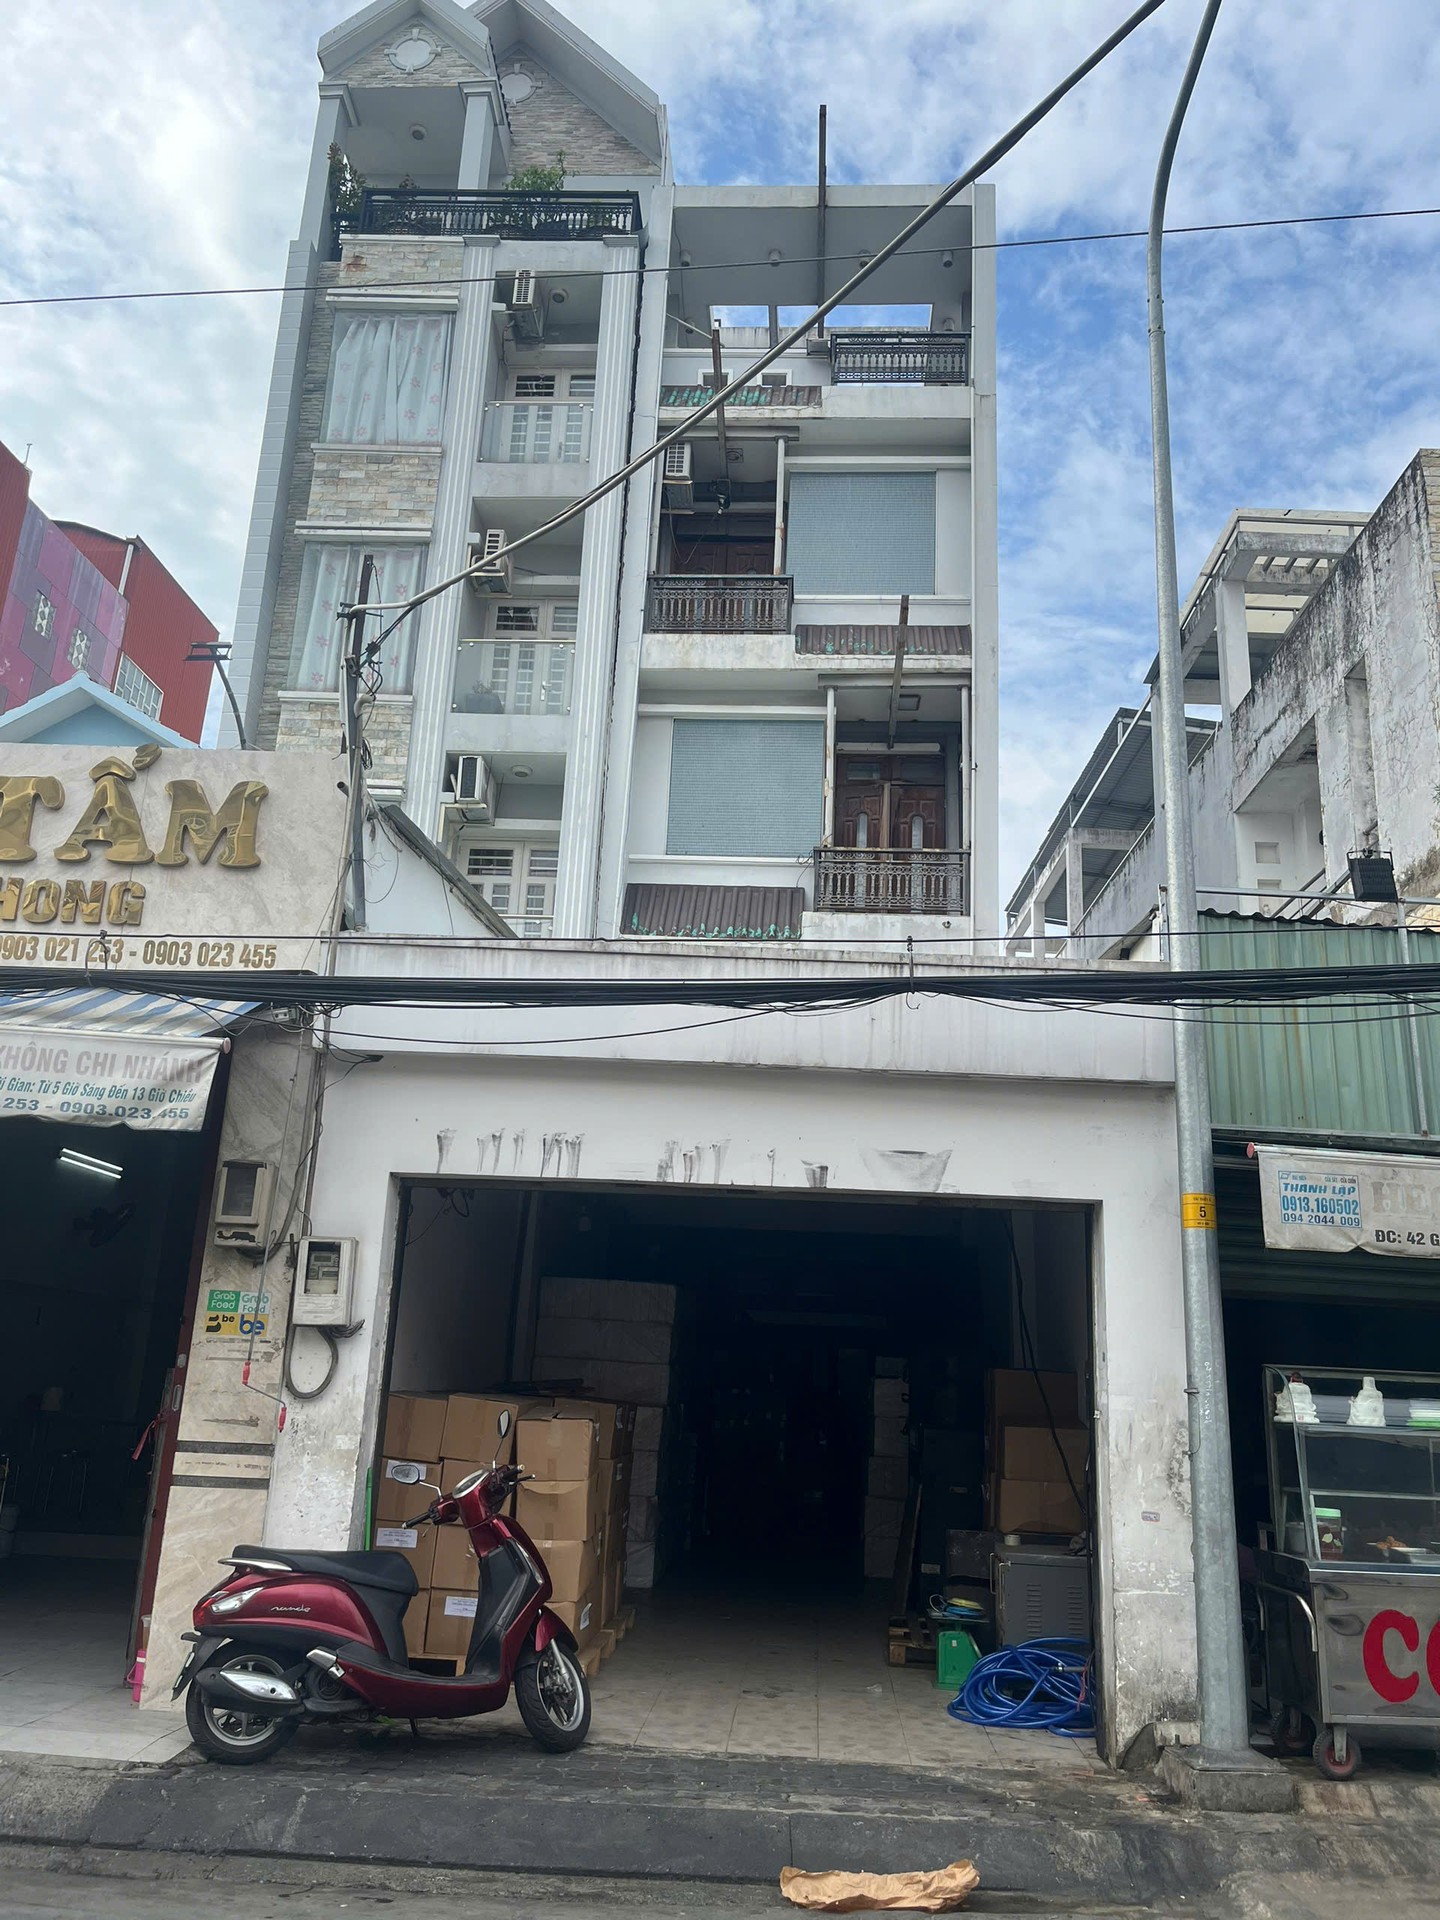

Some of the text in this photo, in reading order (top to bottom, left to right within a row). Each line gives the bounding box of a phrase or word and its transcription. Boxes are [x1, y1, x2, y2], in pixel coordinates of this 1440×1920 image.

[0, 743, 269, 868] TẤM
[0, 934, 39, 961] 903
[44, 937, 79, 961] 021
[88, 938, 124, 963] 253
[143, 940, 193, 966] 0903
[196, 943, 235, 968] 023
[239, 944, 277, 969] 455
[75, 1050, 116, 1077] CHI
[123, 1051, 203, 1083] NHÁNH
[7, 1077, 35, 1092] Gian:
[52, 1081, 61, 1094] 5
[62, 1081, 80, 1096] Giờ
[80, 1083, 106, 1101] Sáng
[108, 1085, 128, 1100] Đến
[132, 1088, 145, 1100] 13
[149, 1088, 166, 1103] Giờ
[59, 1101, 190, 1119] 0903.023.455
[1283, 1183, 1327, 1194] THANH
[1199, 1206, 1207, 1218] 5
[1282, 1195, 1359, 1216] 0913.160502
[1283, 1212, 1360, 1227] 094 2044 009
[1375, 1229, 1402, 1244] ĐC:
[1406, 1231, 1426, 1245] 42
[211, 1299, 235, 1309] Food
[213, 1291, 236, 1300] Grab
[240, 1314, 265, 1335] be
[1363, 1609, 1440, 1704] C
